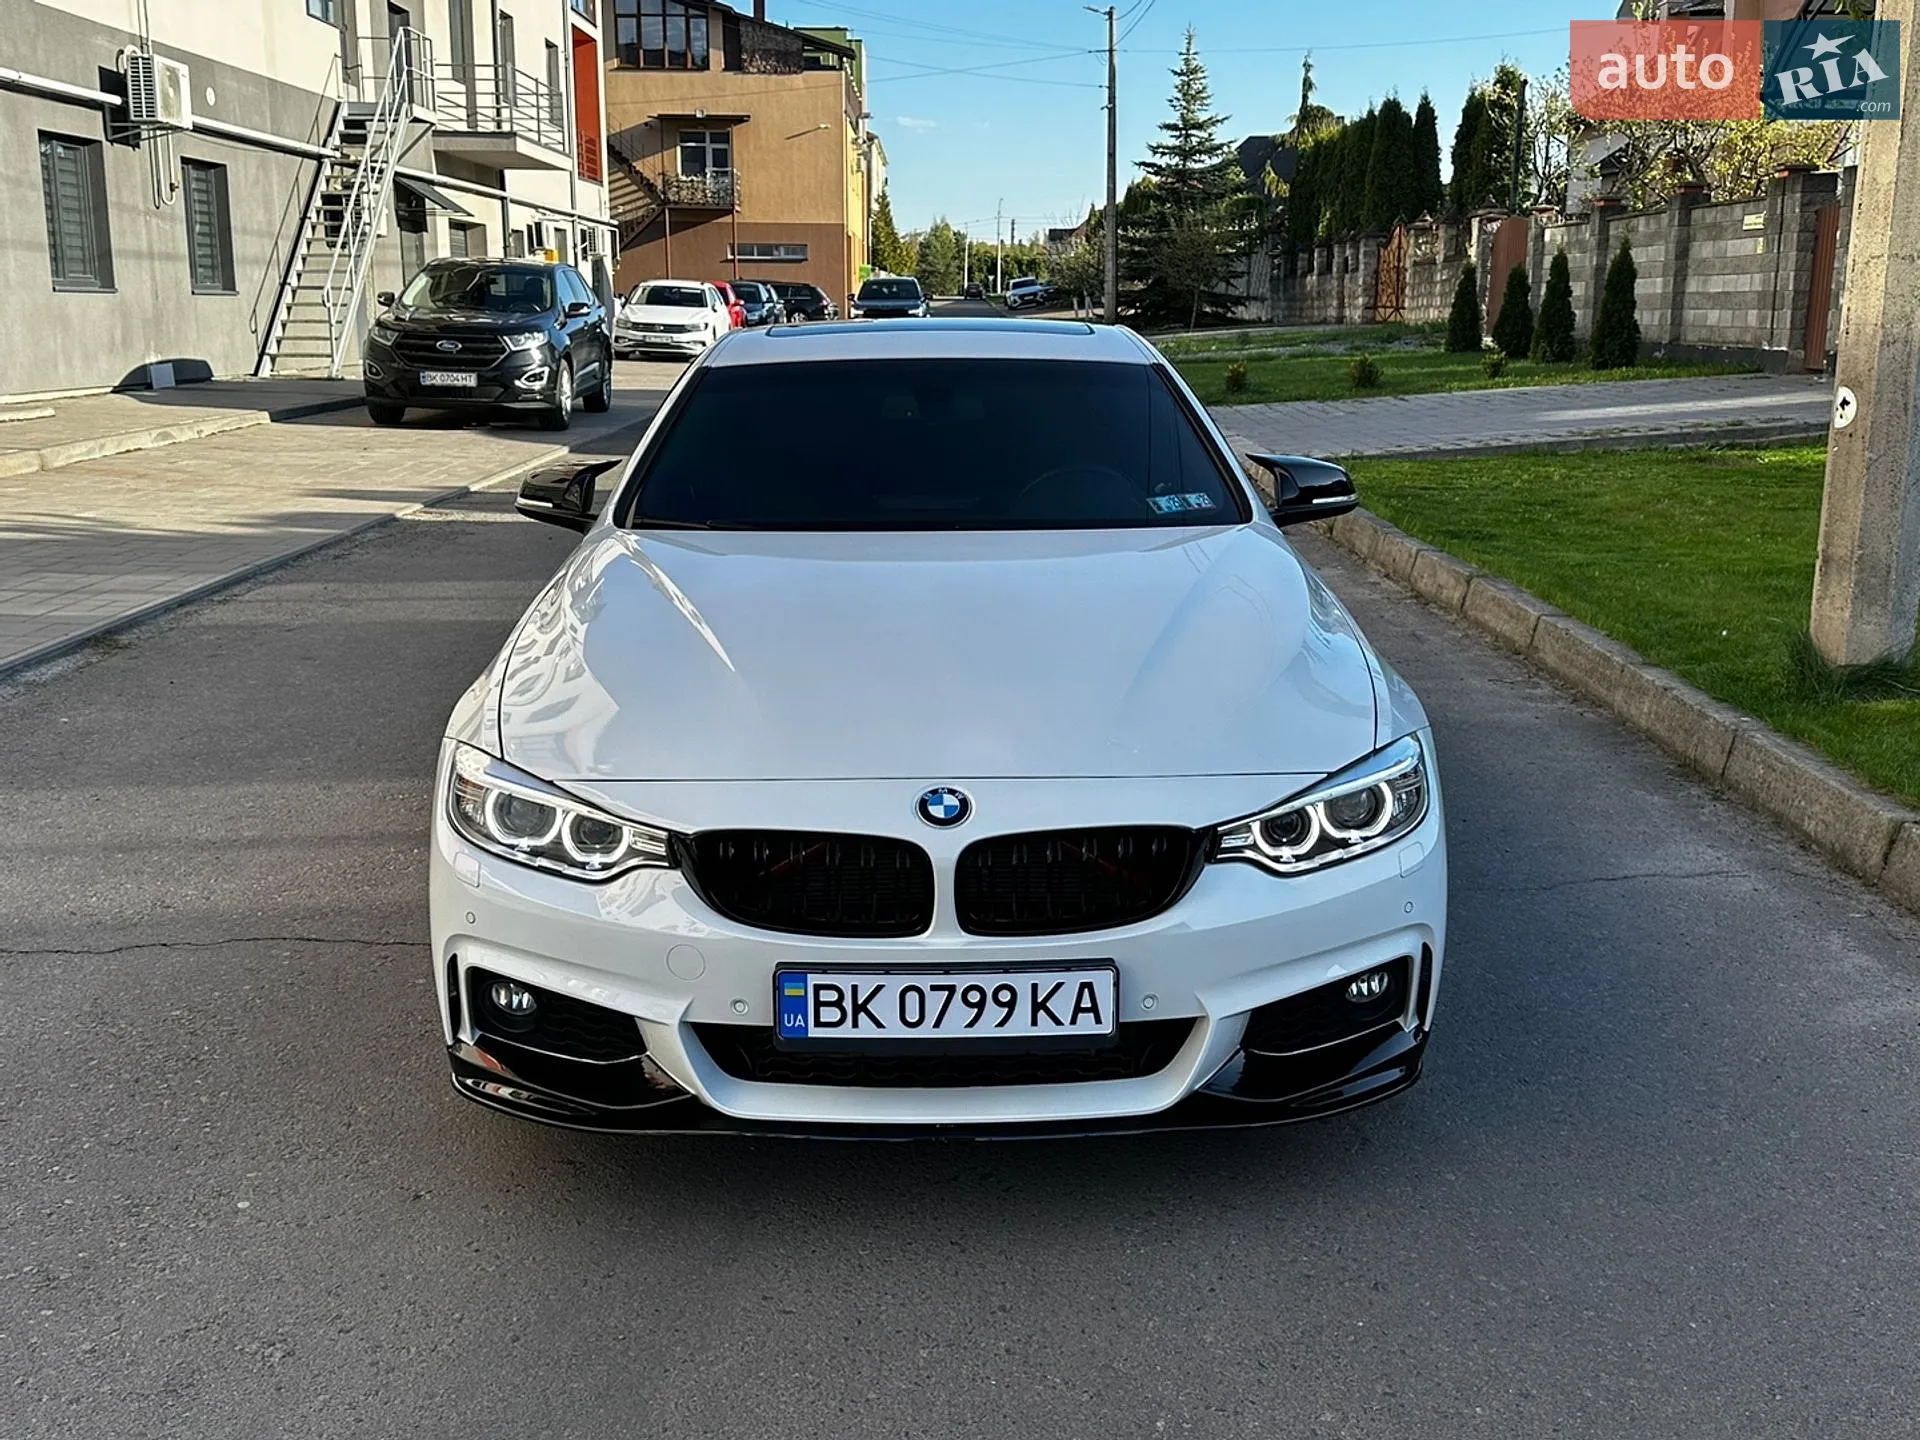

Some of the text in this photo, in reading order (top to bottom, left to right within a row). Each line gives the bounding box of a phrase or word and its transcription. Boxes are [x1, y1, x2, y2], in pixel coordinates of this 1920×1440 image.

[461, 374, 472, 383] HT
[922, 787, 965, 800] BMW
[812, 981, 1103, 1029] BK 0799 KA
[784, 1013, 806, 1028] UA
